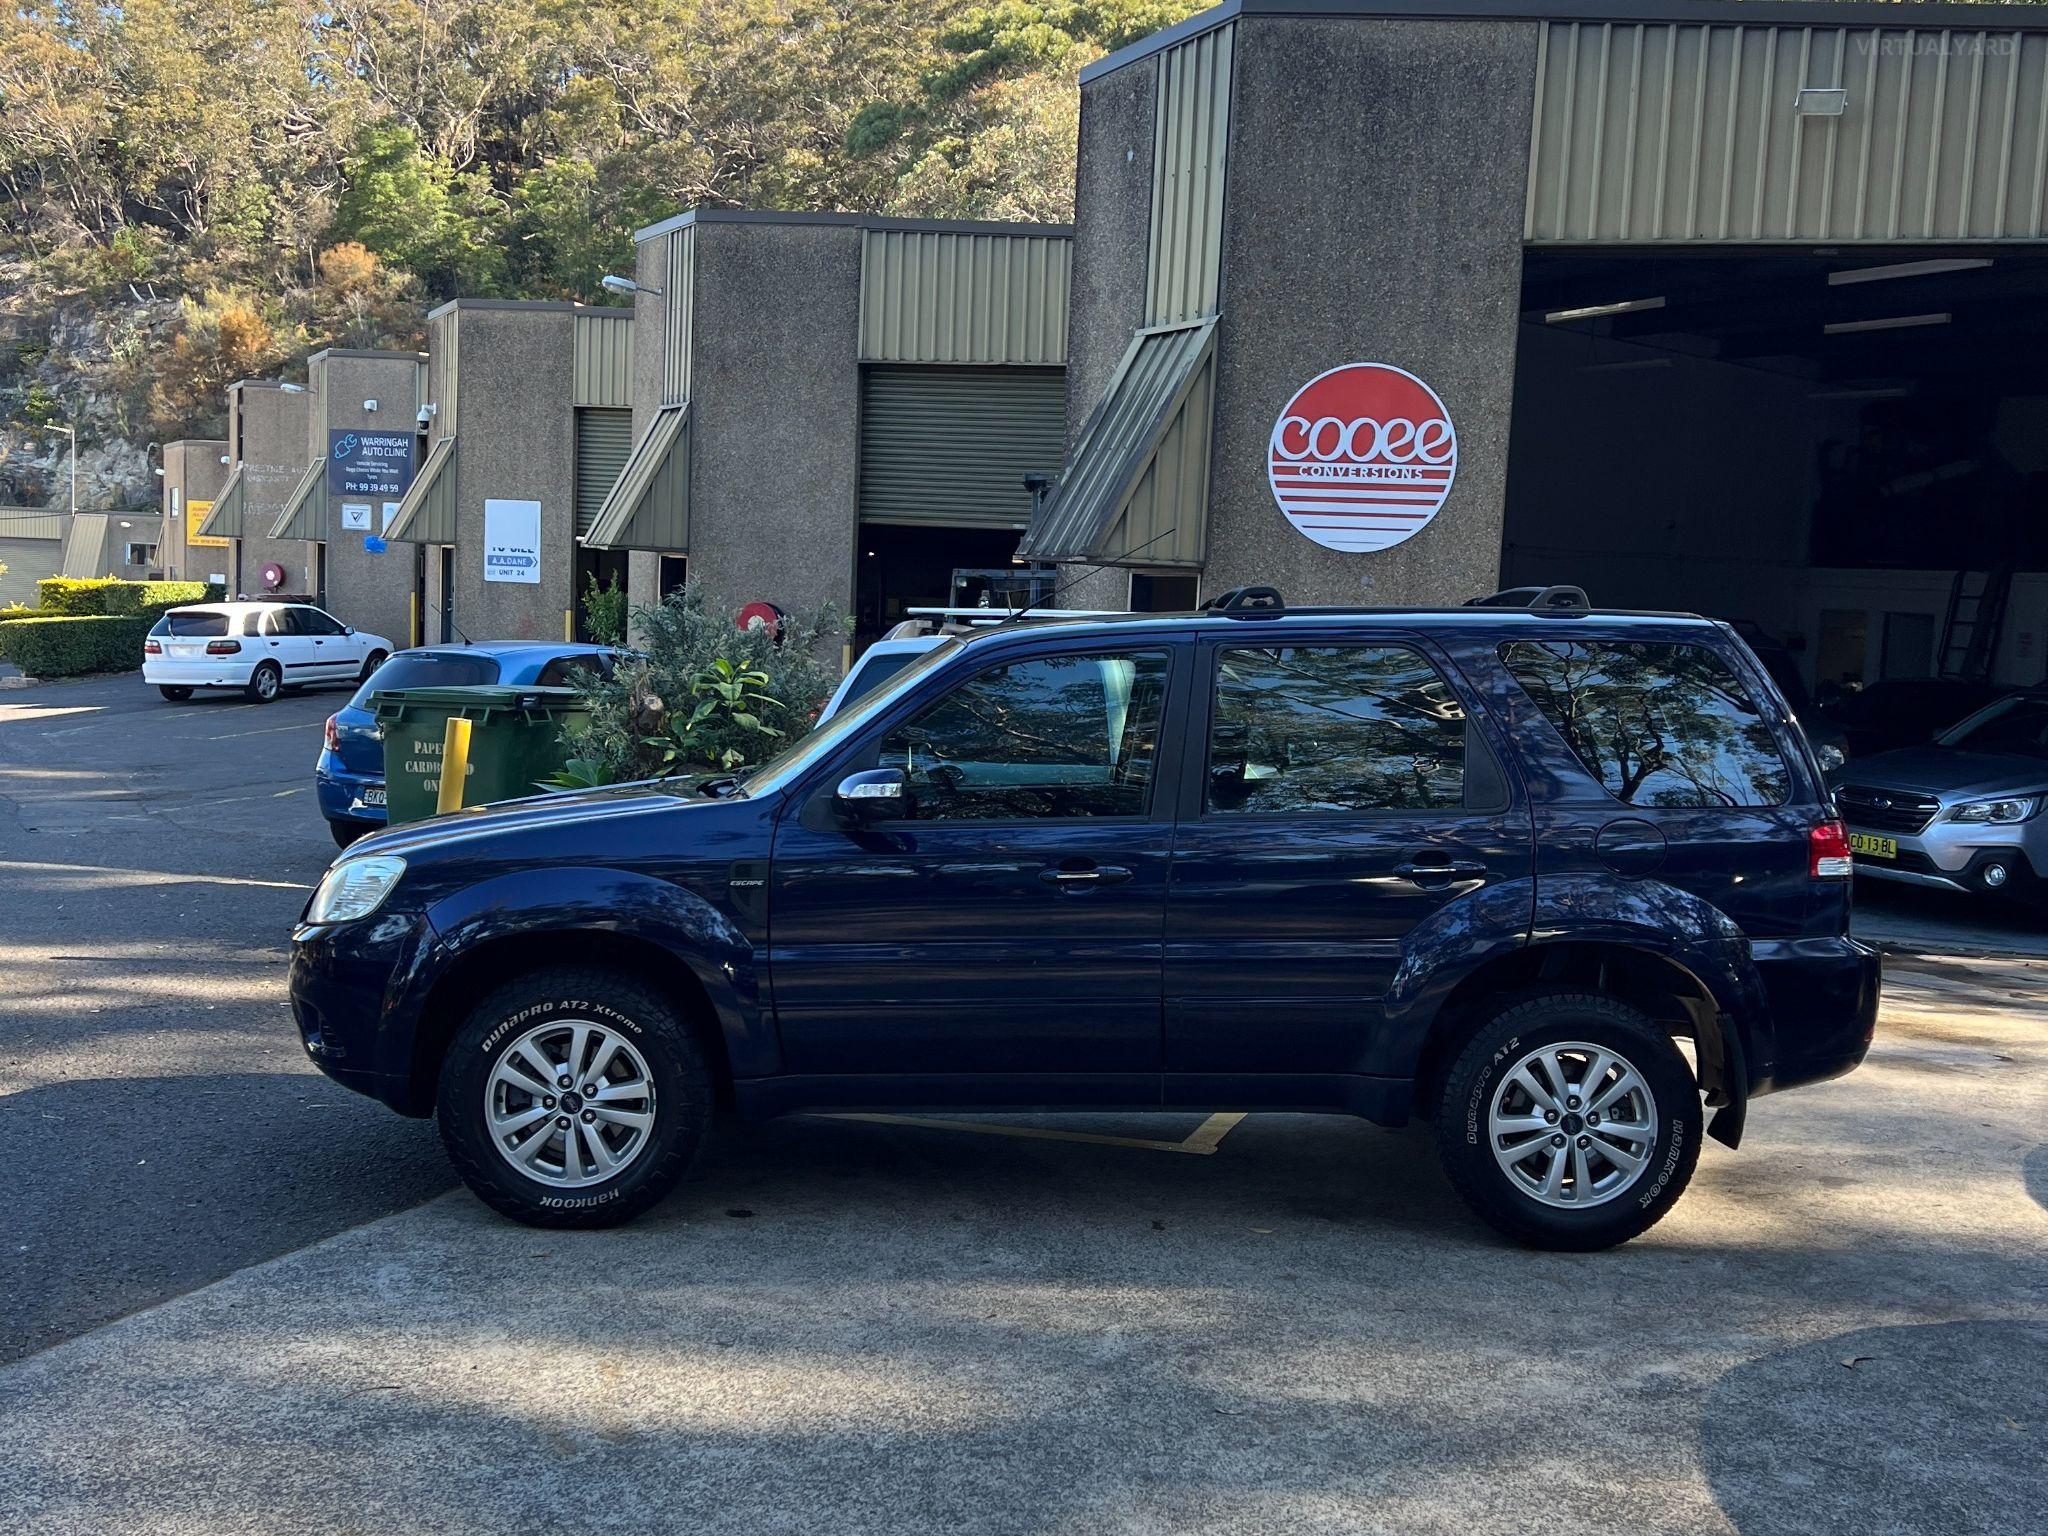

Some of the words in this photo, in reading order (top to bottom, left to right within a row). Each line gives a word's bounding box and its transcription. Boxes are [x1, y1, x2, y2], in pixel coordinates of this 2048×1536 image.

[360, 437, 409, 448] WARRINGAH
[1273, 416, 1453, 464] cooee
[361, 447, 383, 457] AUTO
[384, 448, 408, 458] CLINIC
[1299, 466, 1423, 480] CONVERSIONS
[359, 483, 369, 492] 99
[369, 483, 379, 492] 39
[379, 483, 389, 493] 49
[389, 484, 399, 493] 59
[559, 1000, 588, 1010] AT2
[593, 1003, 643, 1034] Xtreme
[1493, 1036, 1521, 1066] AT2
